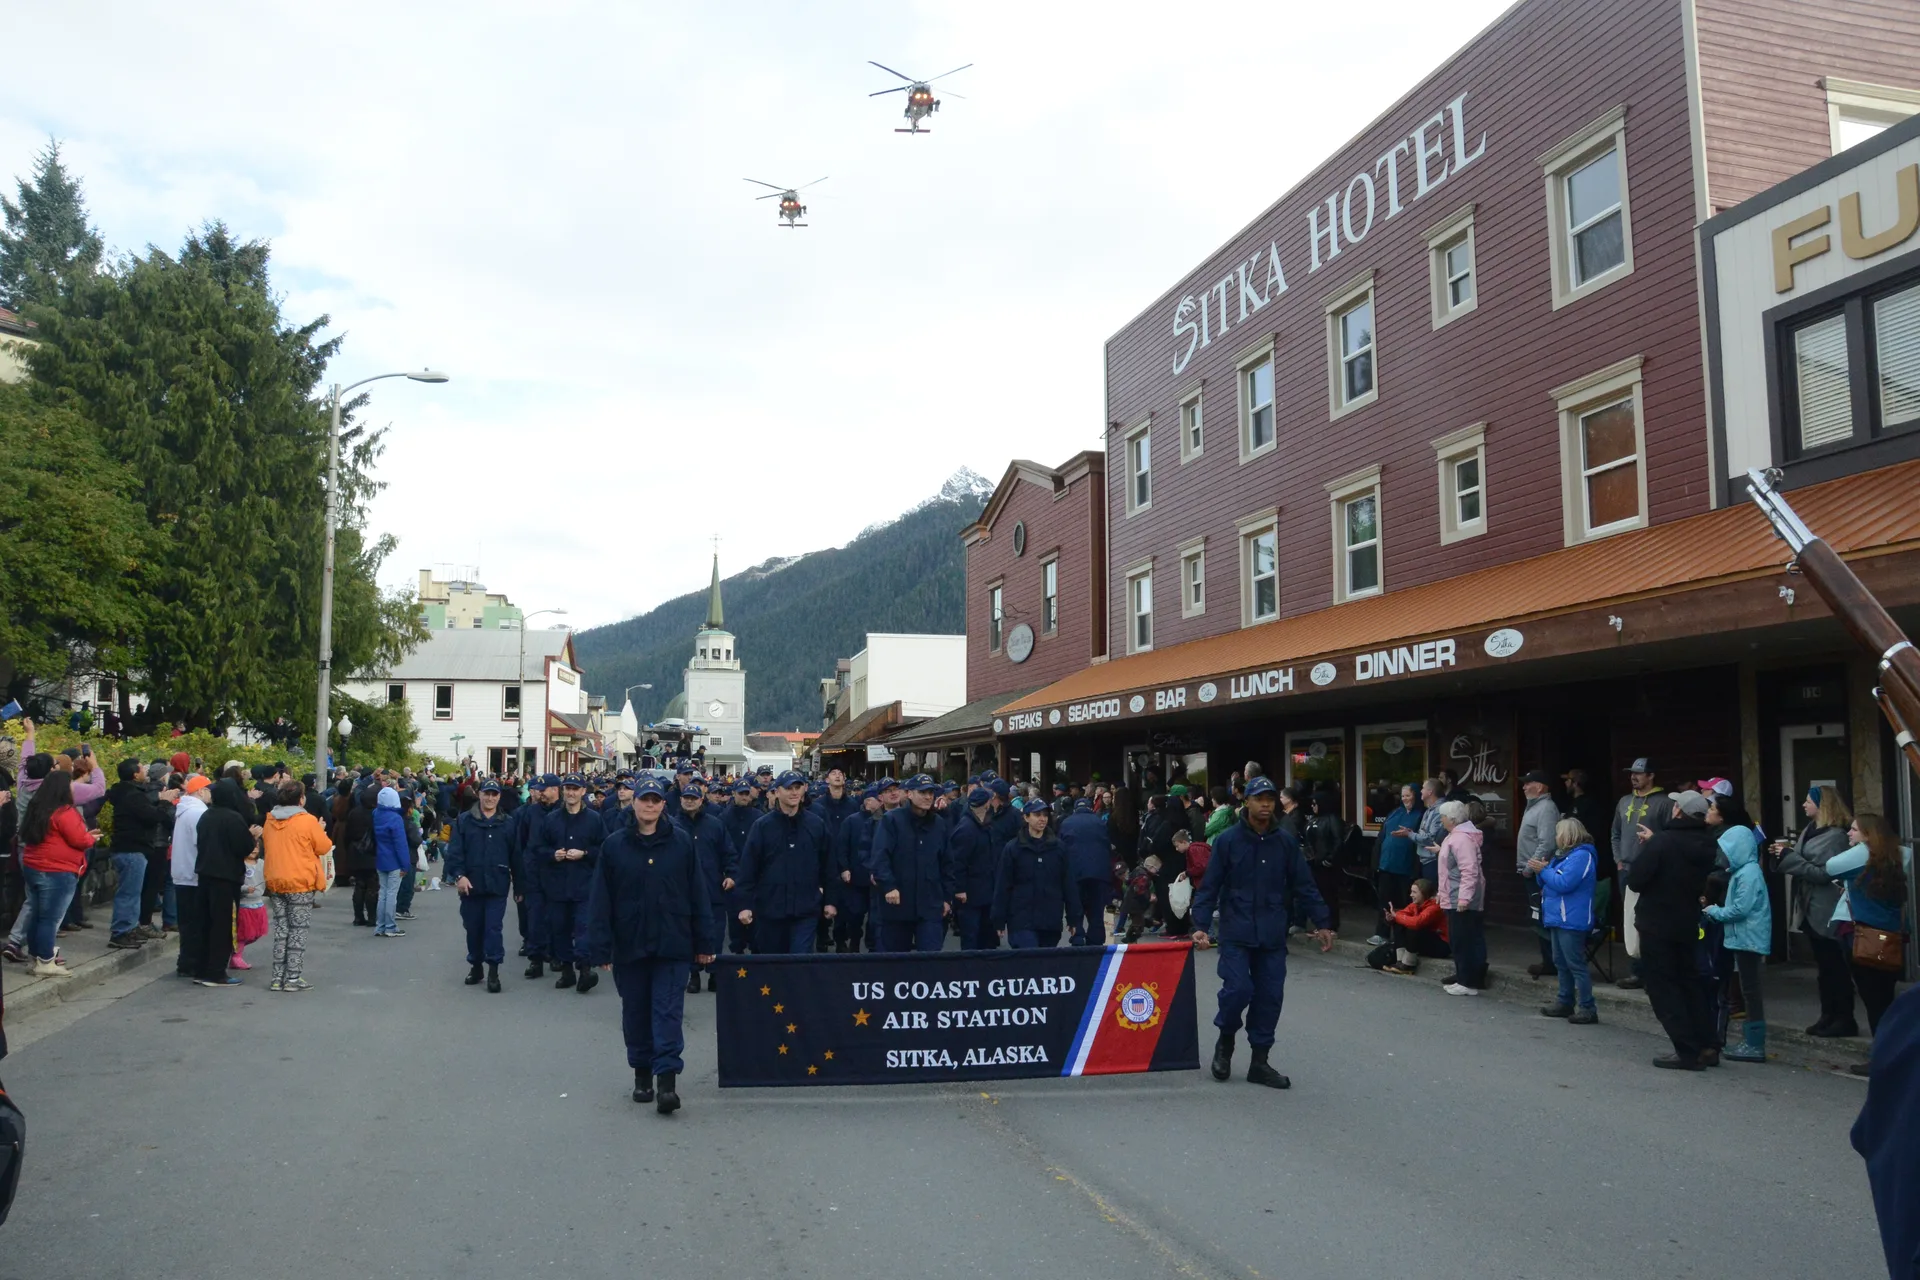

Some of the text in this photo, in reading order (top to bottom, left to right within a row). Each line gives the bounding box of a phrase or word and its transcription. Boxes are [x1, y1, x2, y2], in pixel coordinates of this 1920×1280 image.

[1173, 91, 1487, 375] SITKA HOTEL
[1490, 635, 1516, 651] Sitka
[1008, 711, 1043, 731] STEAKS
[1068, 698, 1120, 722] SEAFOOD
[1155, 686, 1186, 711] BAR
[1230, 668, 1293, 699] LUNCH
[1355, 638, 1456, 681] DINNER
[1449, 734, 1508, 786] Sitka
[852, 976, 1076, 1000] US COAST GUARD
[882, 1006, 1048, 1029] AIR STATION
[886, 1045, 1049, 1069] SITKA, ALASKA
